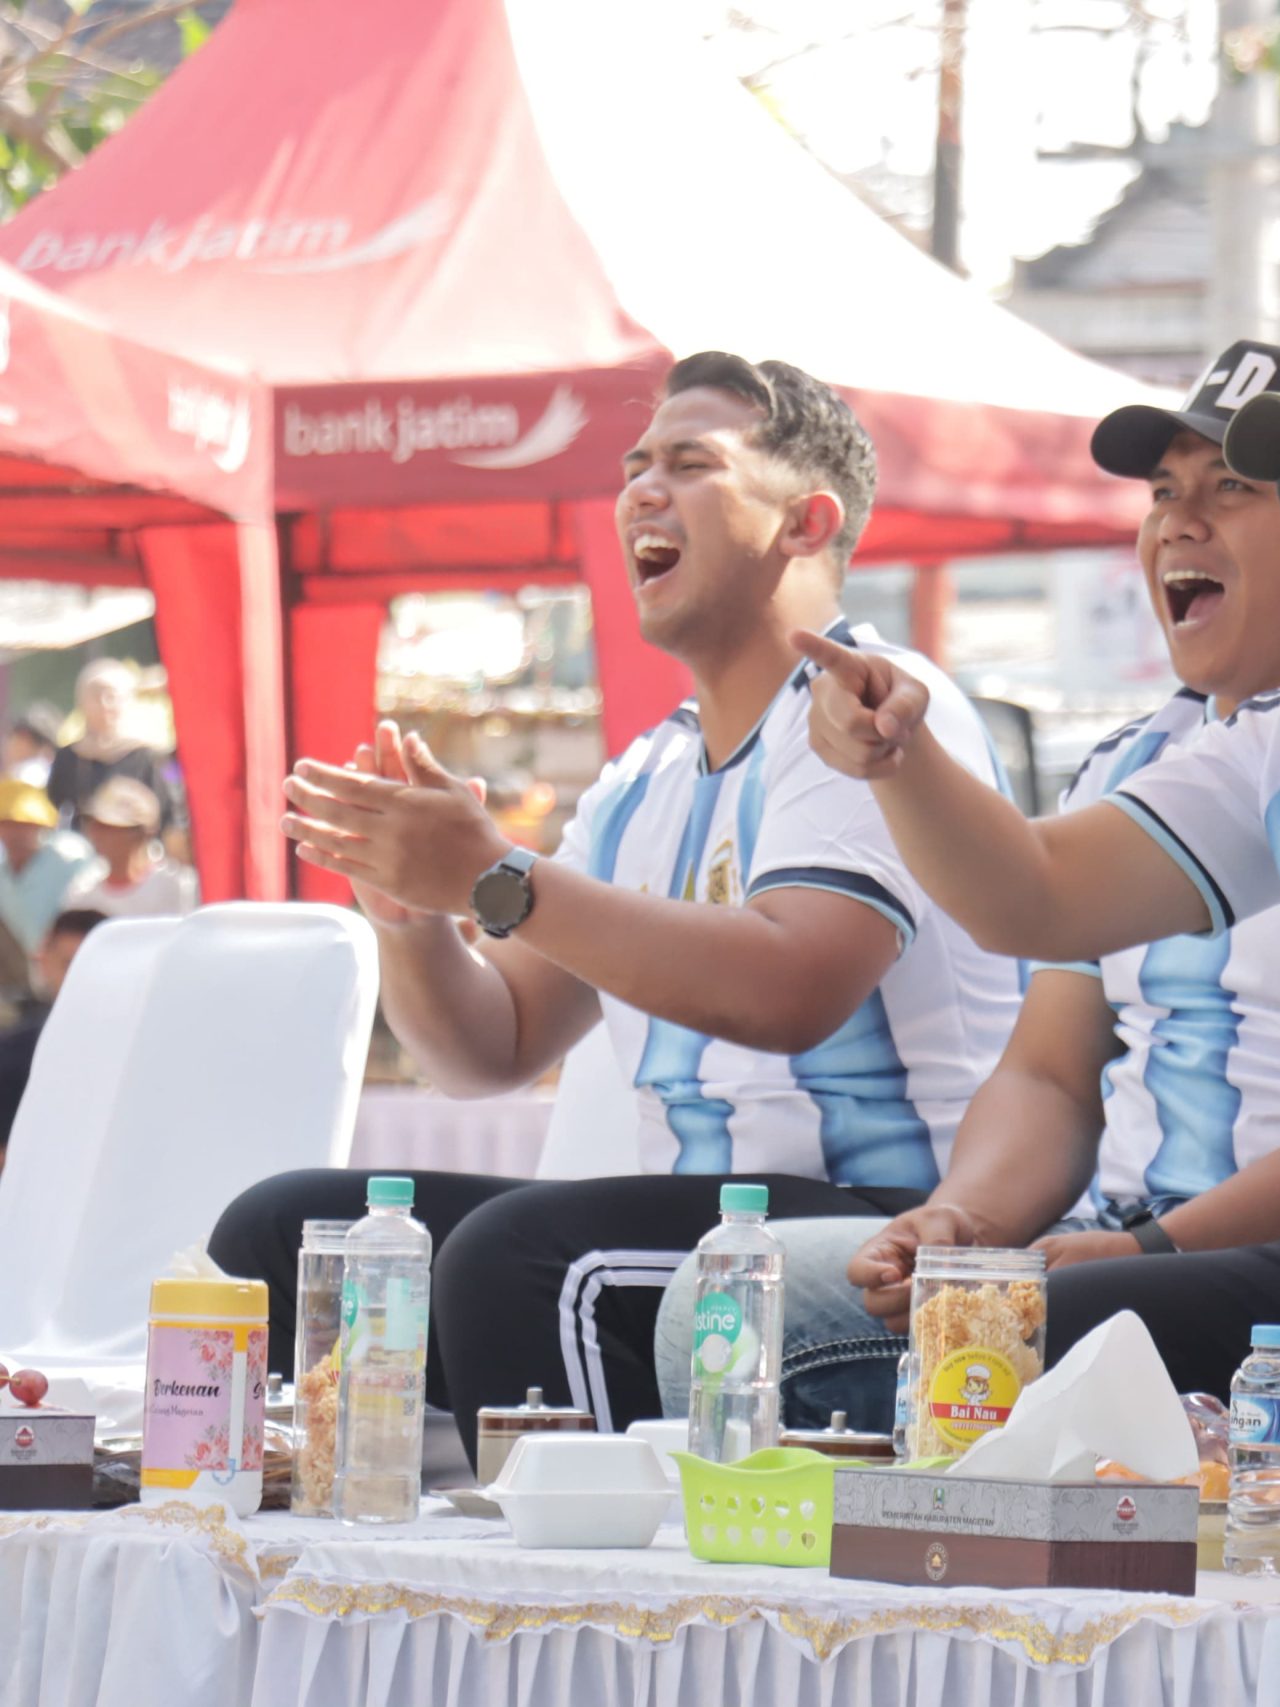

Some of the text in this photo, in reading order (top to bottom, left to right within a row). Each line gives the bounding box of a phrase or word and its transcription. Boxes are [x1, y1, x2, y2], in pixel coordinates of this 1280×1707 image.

[18, 213, 352, 273] bank jatim
[284, 399, 392, 456] bank
[394, 395, 518, 463] jatim
[973, 1406, 998, 1421] Nau
